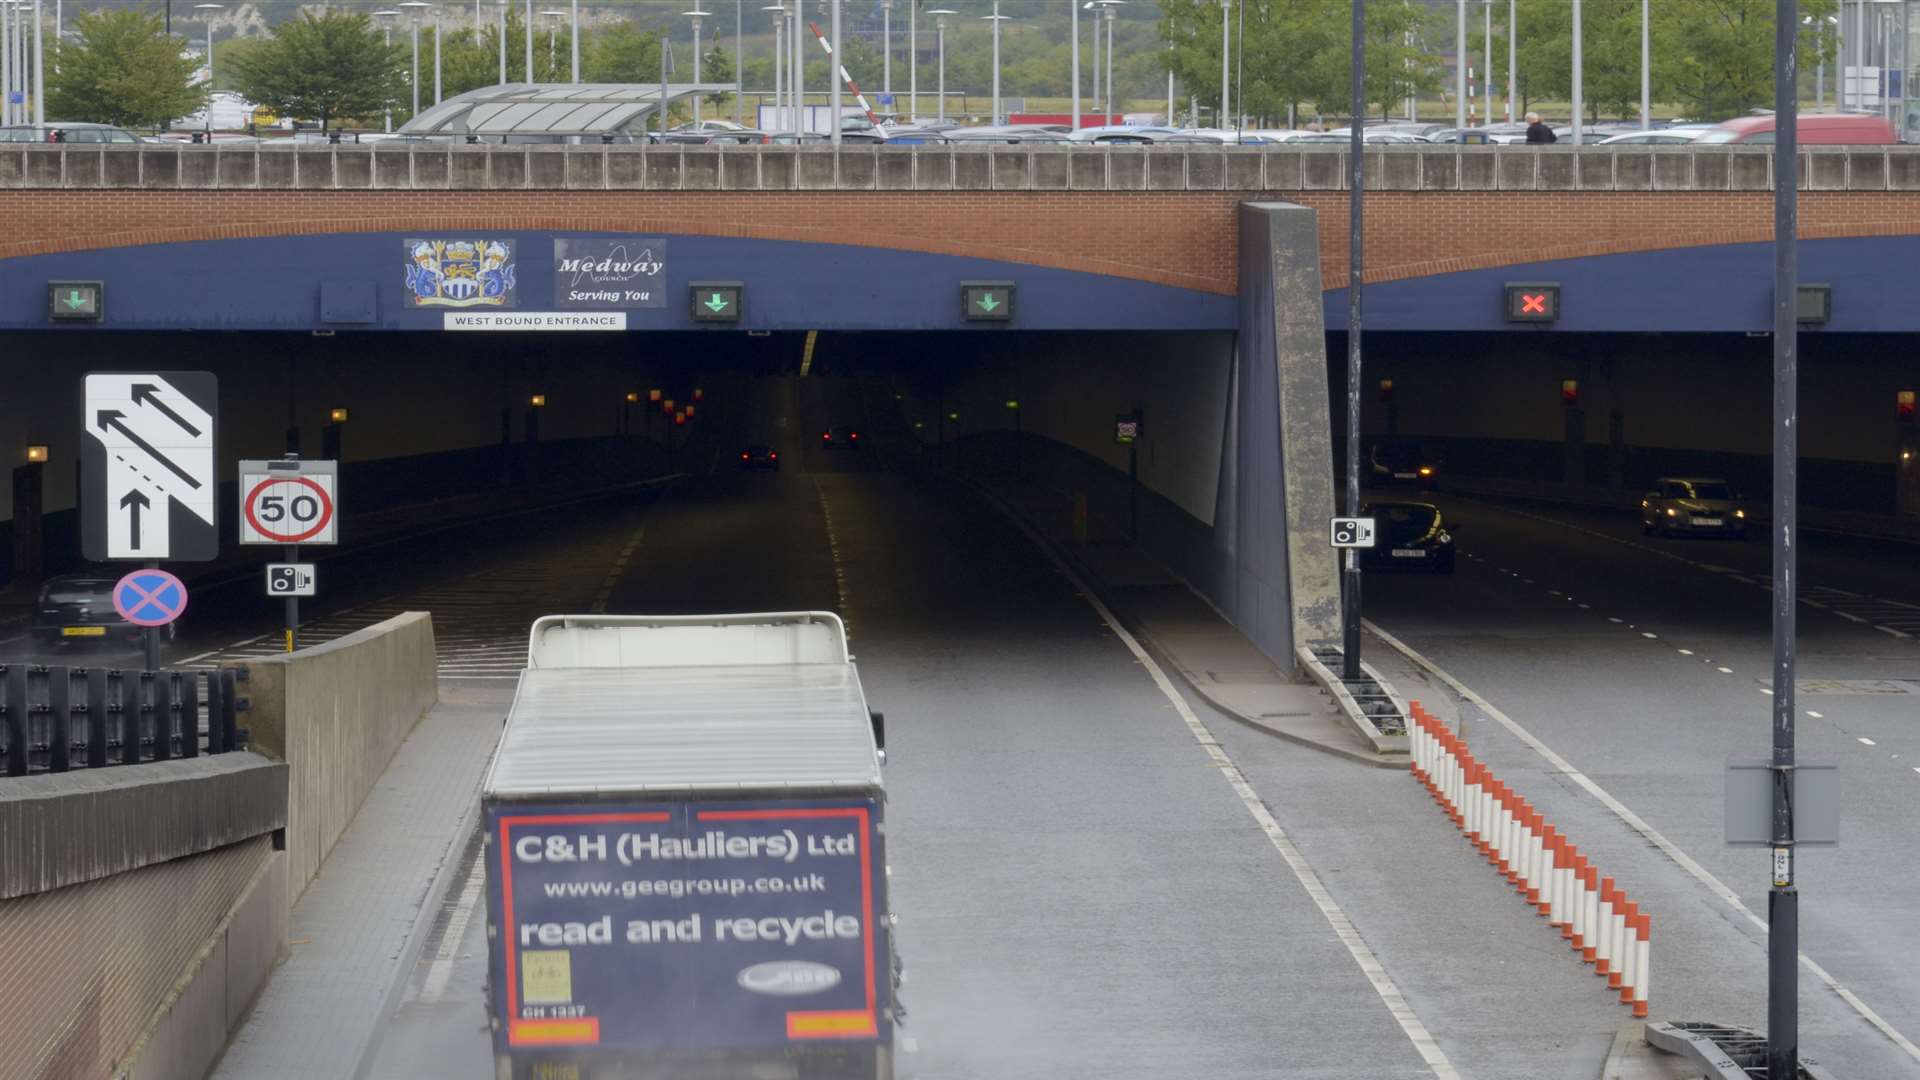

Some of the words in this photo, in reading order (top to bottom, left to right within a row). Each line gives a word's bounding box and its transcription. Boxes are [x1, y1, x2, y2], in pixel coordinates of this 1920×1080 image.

[559, 258, 663, 276] Medway
[568, 289, 620, 303] Serving
[625, 289, 650, 302] You
[455, 316, 491, 325] WEST
[495, 316, 542, 325] BOUND
[546, 316, 617, 325] ENTRANCE
[260, 494, 319, 523] 50
[515, 834, 607, 863] C&H
[616, 829, 799, 866] (Hauliers)
[807, 833, 856, 856] Ltd
[544, 873, 825, 898] www.geegroup.co.uk
[521, 914, 612, 946] read
[626, 913, 701, 943] and
[715, 909, 860, 946] recycle
